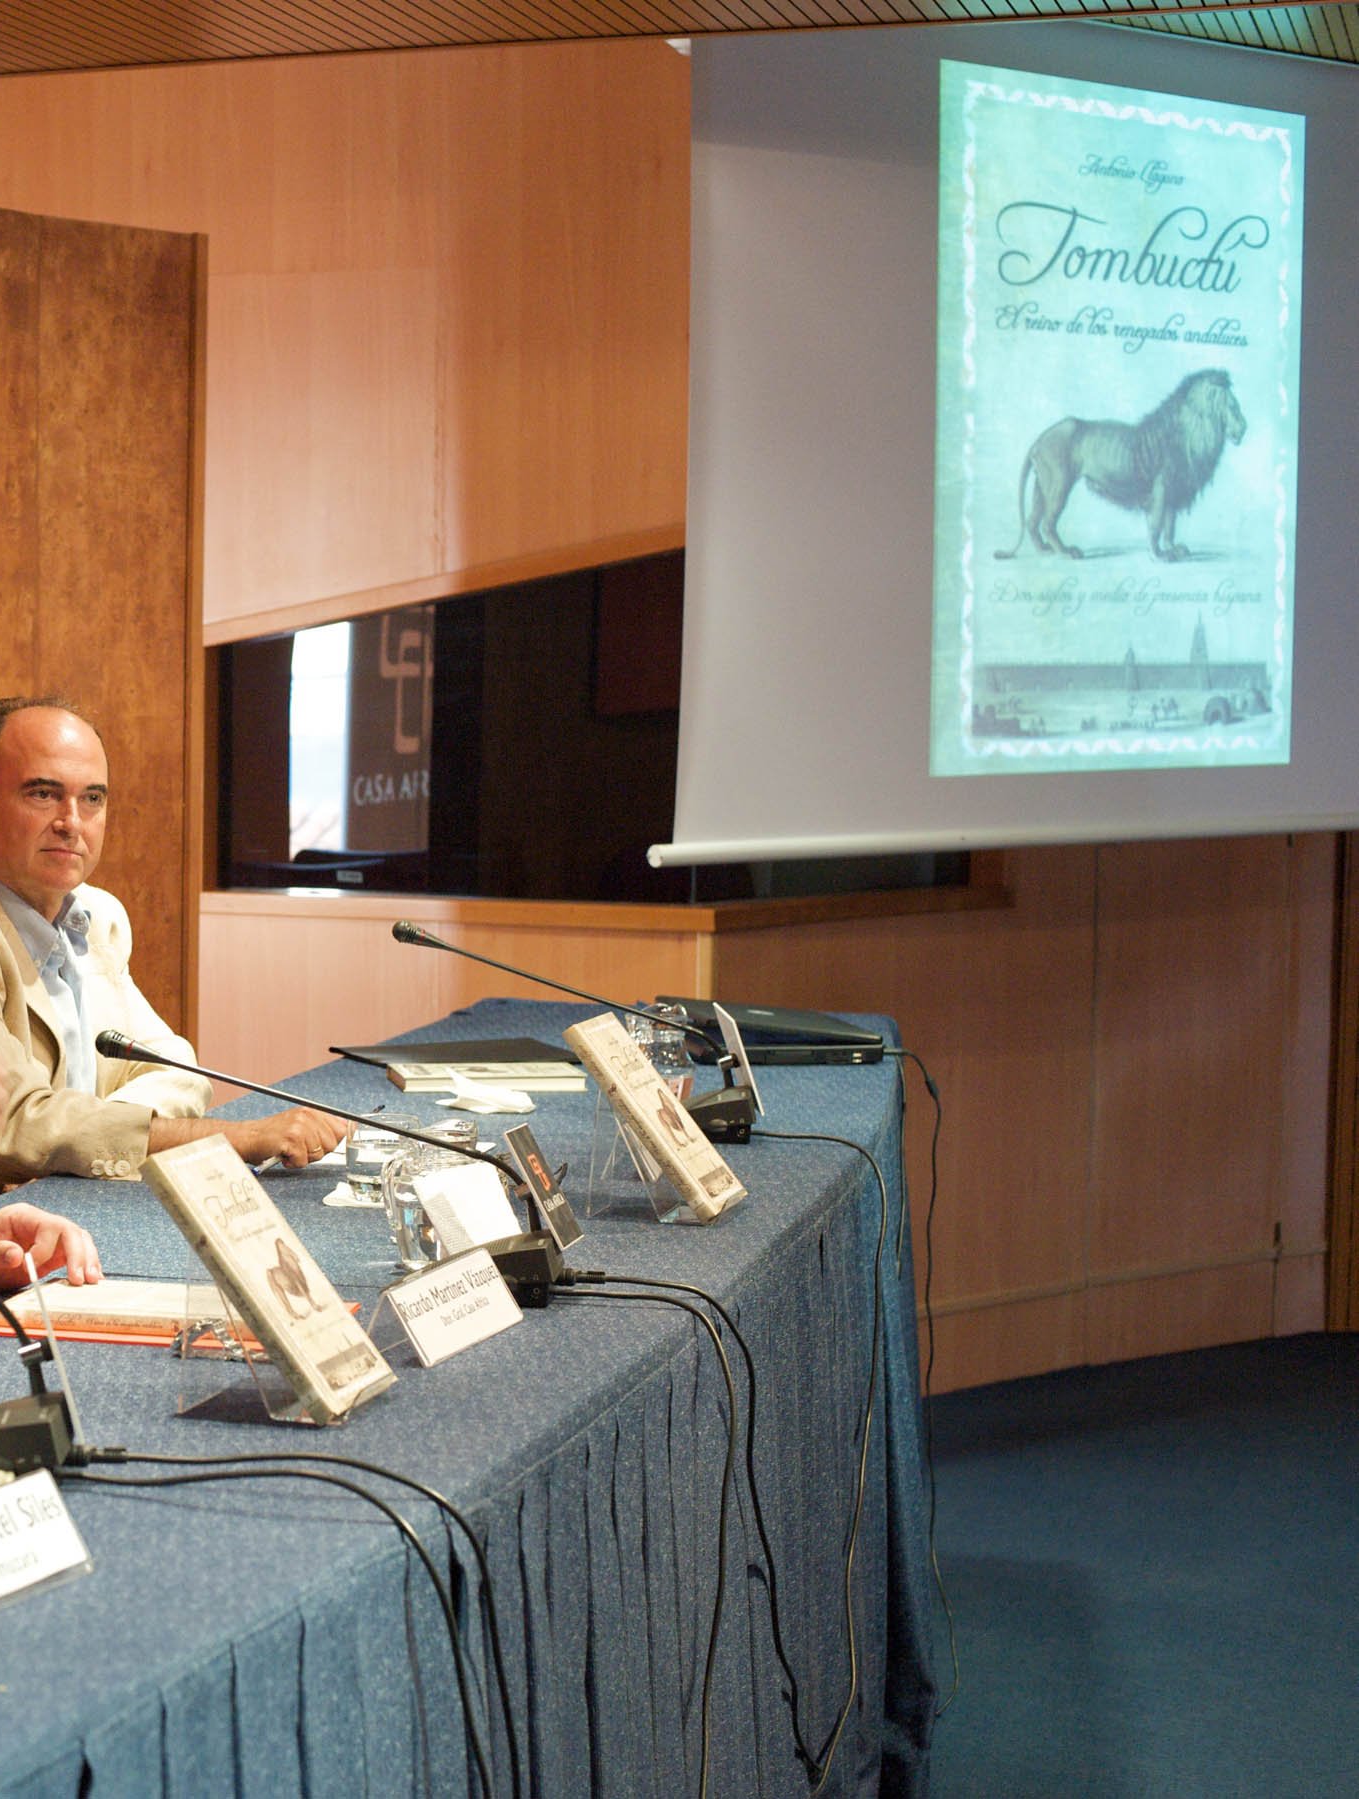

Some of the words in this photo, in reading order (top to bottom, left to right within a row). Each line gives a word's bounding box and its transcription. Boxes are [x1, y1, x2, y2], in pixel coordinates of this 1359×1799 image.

[995, 300, 1039, 330] El
[1025, 315, 1061, 333] reino
[1066, 305, 1097, 335] de
[1088, 307, 1114, 336] los
[1114, 312, 1186, 354] renegados
[1184, 317, 1249, 348] andaluces
[353, 773, 395, 807] CASA
[397, 1292, 434, 1323] Ricardo
[16, 1493, 64, 1529] Siles
